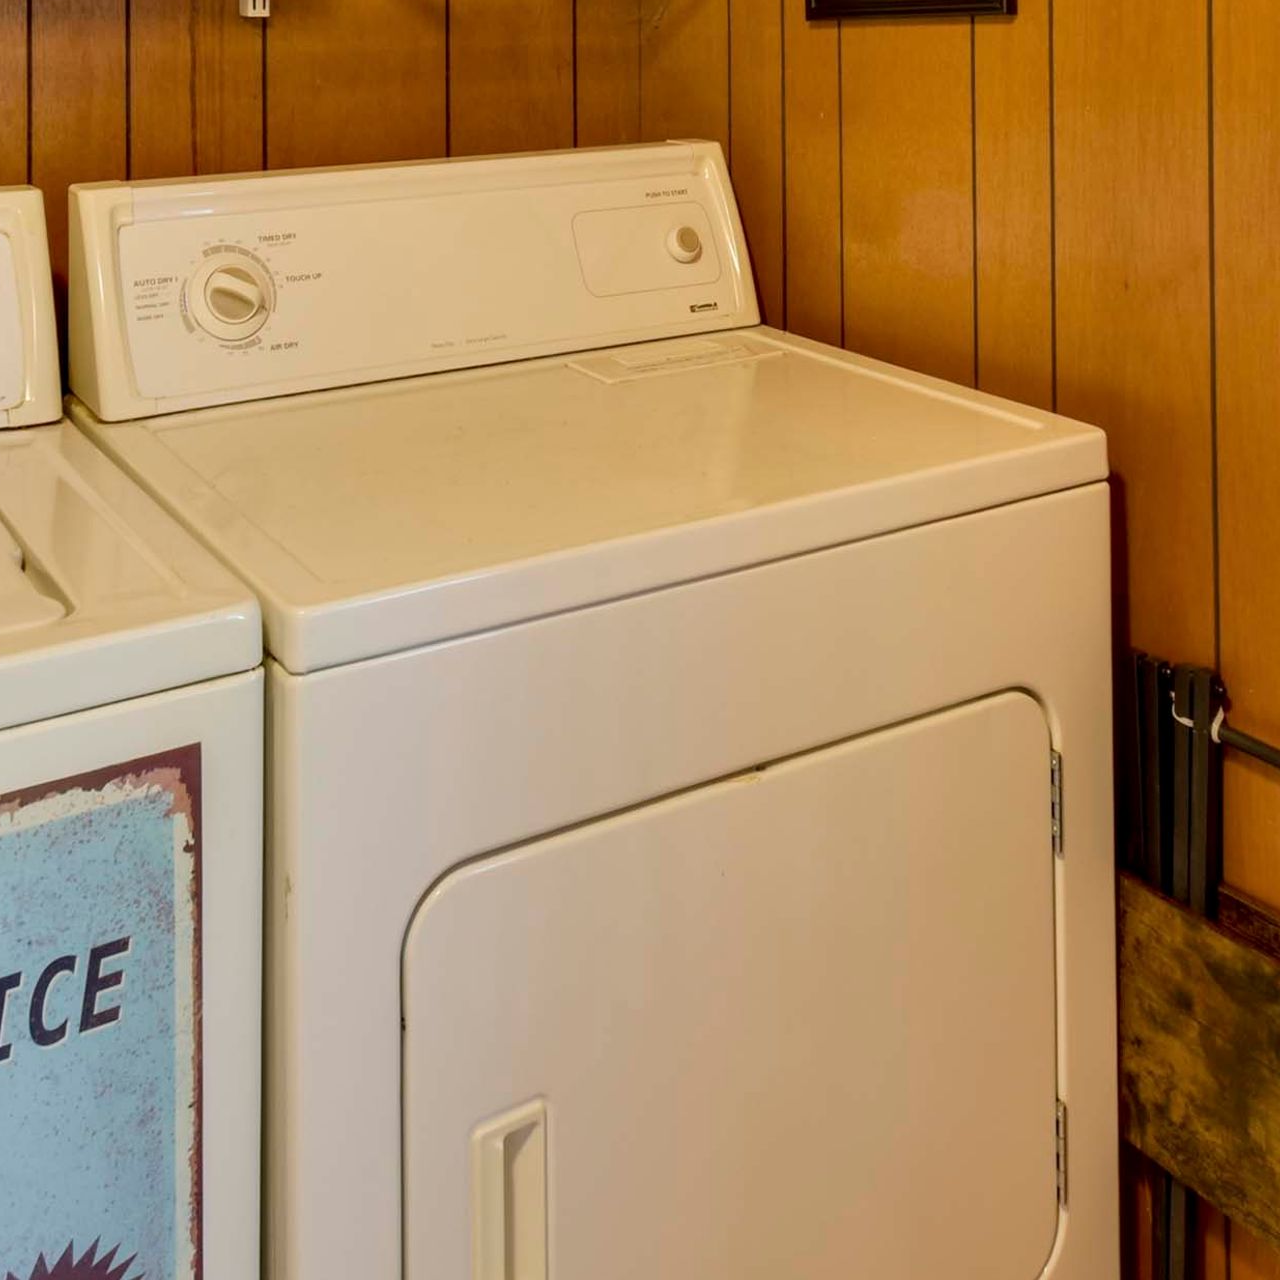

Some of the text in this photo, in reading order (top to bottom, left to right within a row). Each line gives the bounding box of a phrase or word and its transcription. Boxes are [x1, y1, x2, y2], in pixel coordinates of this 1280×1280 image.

[258, 234, 280, 242] TIMED
[286, 272, 322, 282] TOUCH UP
[133, 278, 156, 287] AUTO
[157, 277, 173, 285] DRY
[284, 341, 298, 349] DRY
